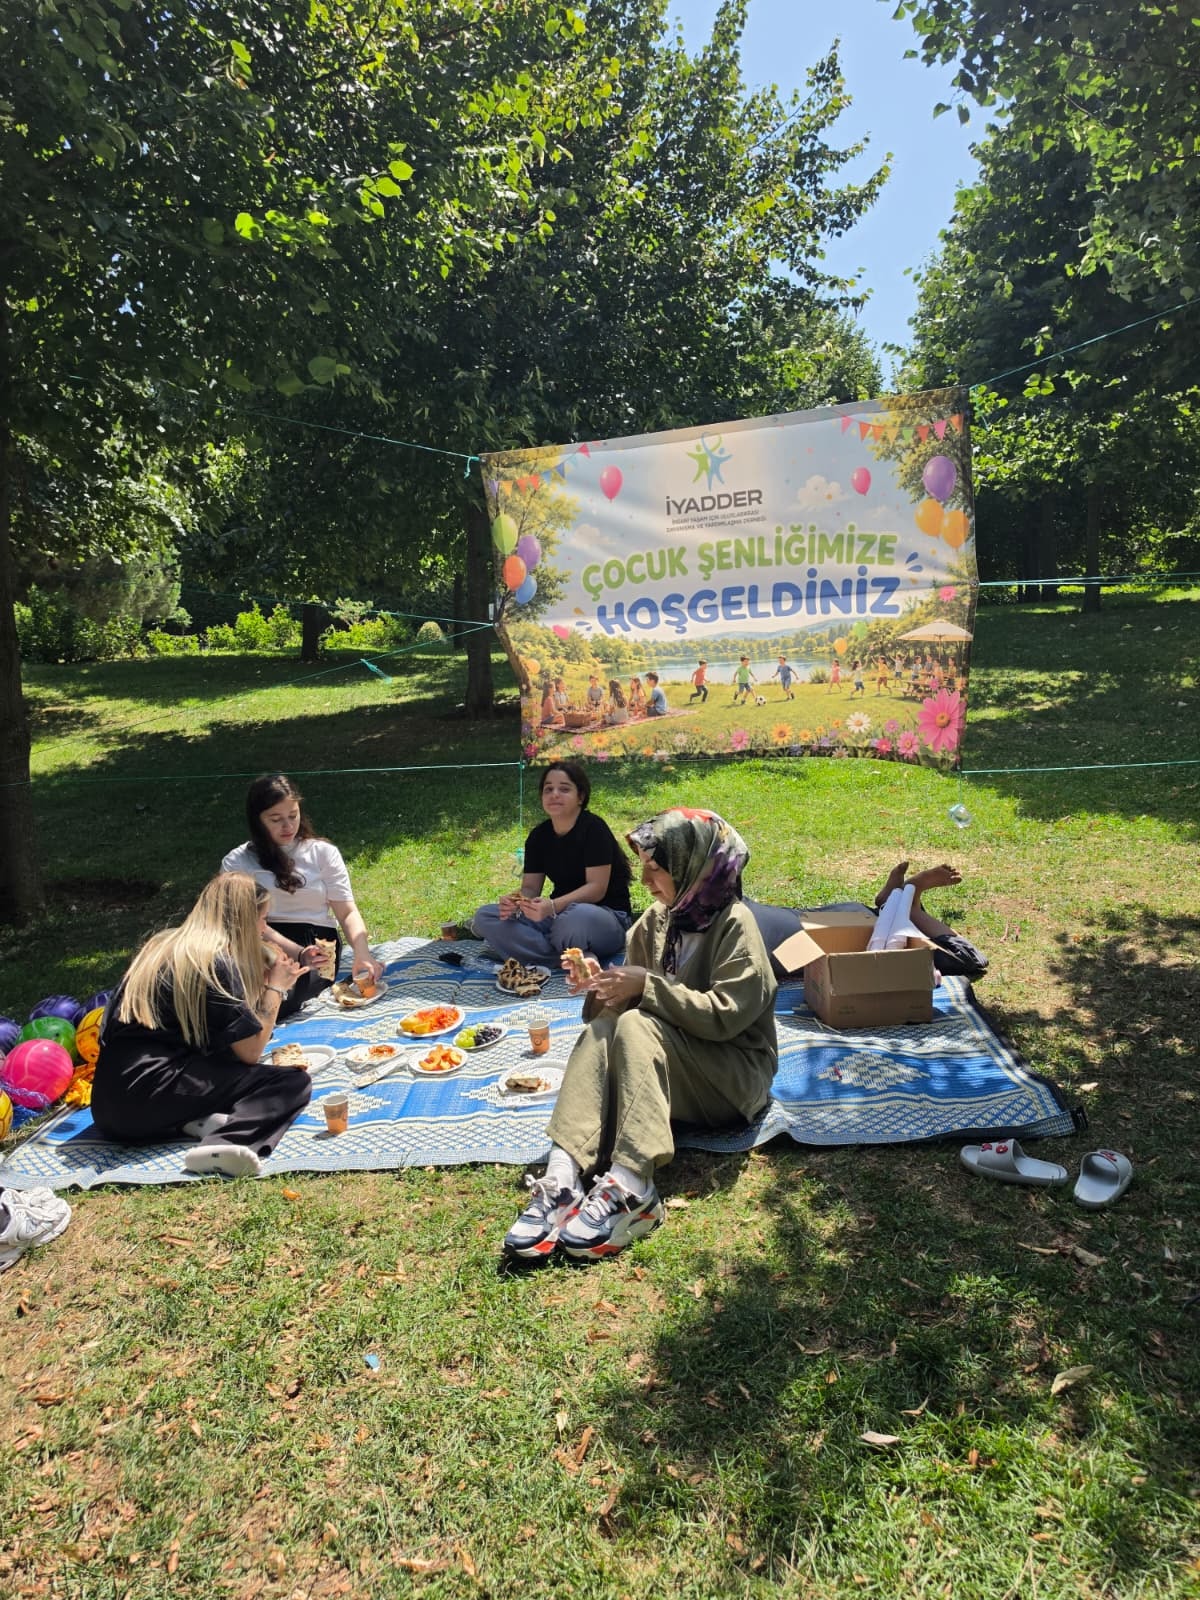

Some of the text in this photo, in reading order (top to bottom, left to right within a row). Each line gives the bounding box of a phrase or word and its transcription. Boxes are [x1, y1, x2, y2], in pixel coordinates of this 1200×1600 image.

[666, 489, 763, 516] İYADDER
[582, 524, 898, 602] ÇOCUK ŞENLİĞİMİZE
[597, 565, 901, 635] HOŞGELDİNİZ
